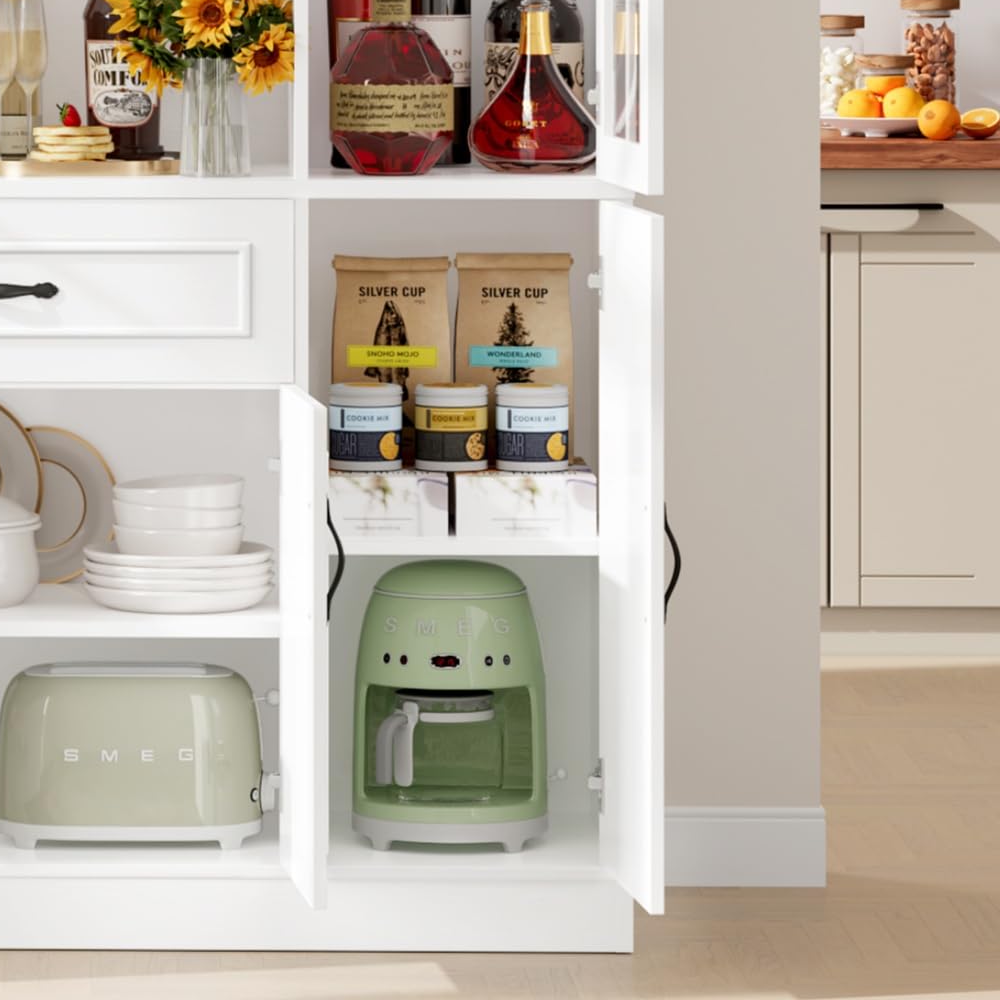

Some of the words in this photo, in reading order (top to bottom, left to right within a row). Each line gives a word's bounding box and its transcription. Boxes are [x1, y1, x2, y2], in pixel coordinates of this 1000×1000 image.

[359, 286, 398, 297] SILVER
[402, 286, 426, 297] CUP
[481, 287, 521, 298] SILVER
[524, 287, 549, 299] CUP
[397, 350, 420, 358] MOJO
[384, 616, 510, 637] SMEG
[63, 748, 194, 762] SMEG
